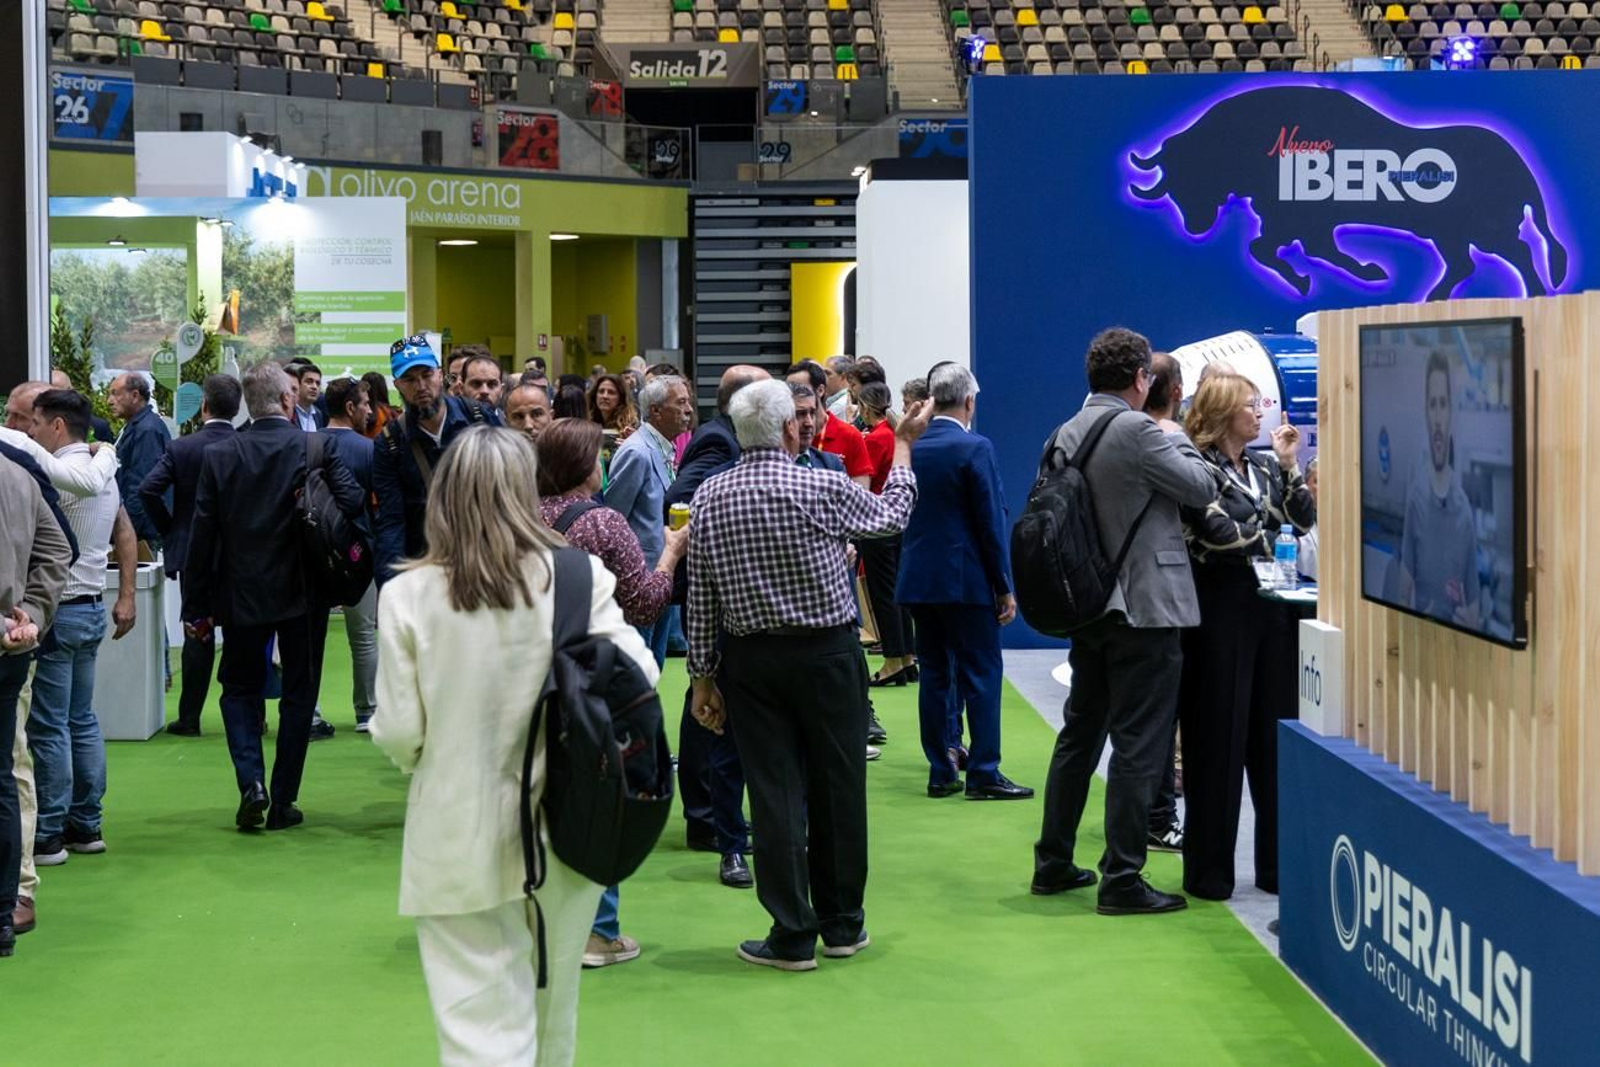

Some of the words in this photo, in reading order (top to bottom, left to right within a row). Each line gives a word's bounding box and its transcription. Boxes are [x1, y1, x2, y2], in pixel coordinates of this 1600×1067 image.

[630, 60, 696, 78] Salida
[698, 49, 728, 78] 12
[52, 73, 105, 92] Sector
[768, 81, 797, 90] Sector
[55, 95, 89, 124] 26
[498, 111, 536, 127] Sector
[898, 119, 948, 133] Sector
[1267, 125, 1334, 158] Nuevo
[340, 169, 417, 203] olivo
[427, 178, 520, 209] arena
[1278, 147, 1458, 203] IBERO
[1388, 170, 1455, 182] PIERALISI
[435, 211, 476, 225] PARAÍSO
[477, 214, 520, 227] INTERIOR
[155, 352, 175, 364] 40
[1300, 650, 1321, 706] Info
[1363, 850, 1532, 1064] PIERALISI
[1363, 941, 1437, 1032] CIRCULAR
